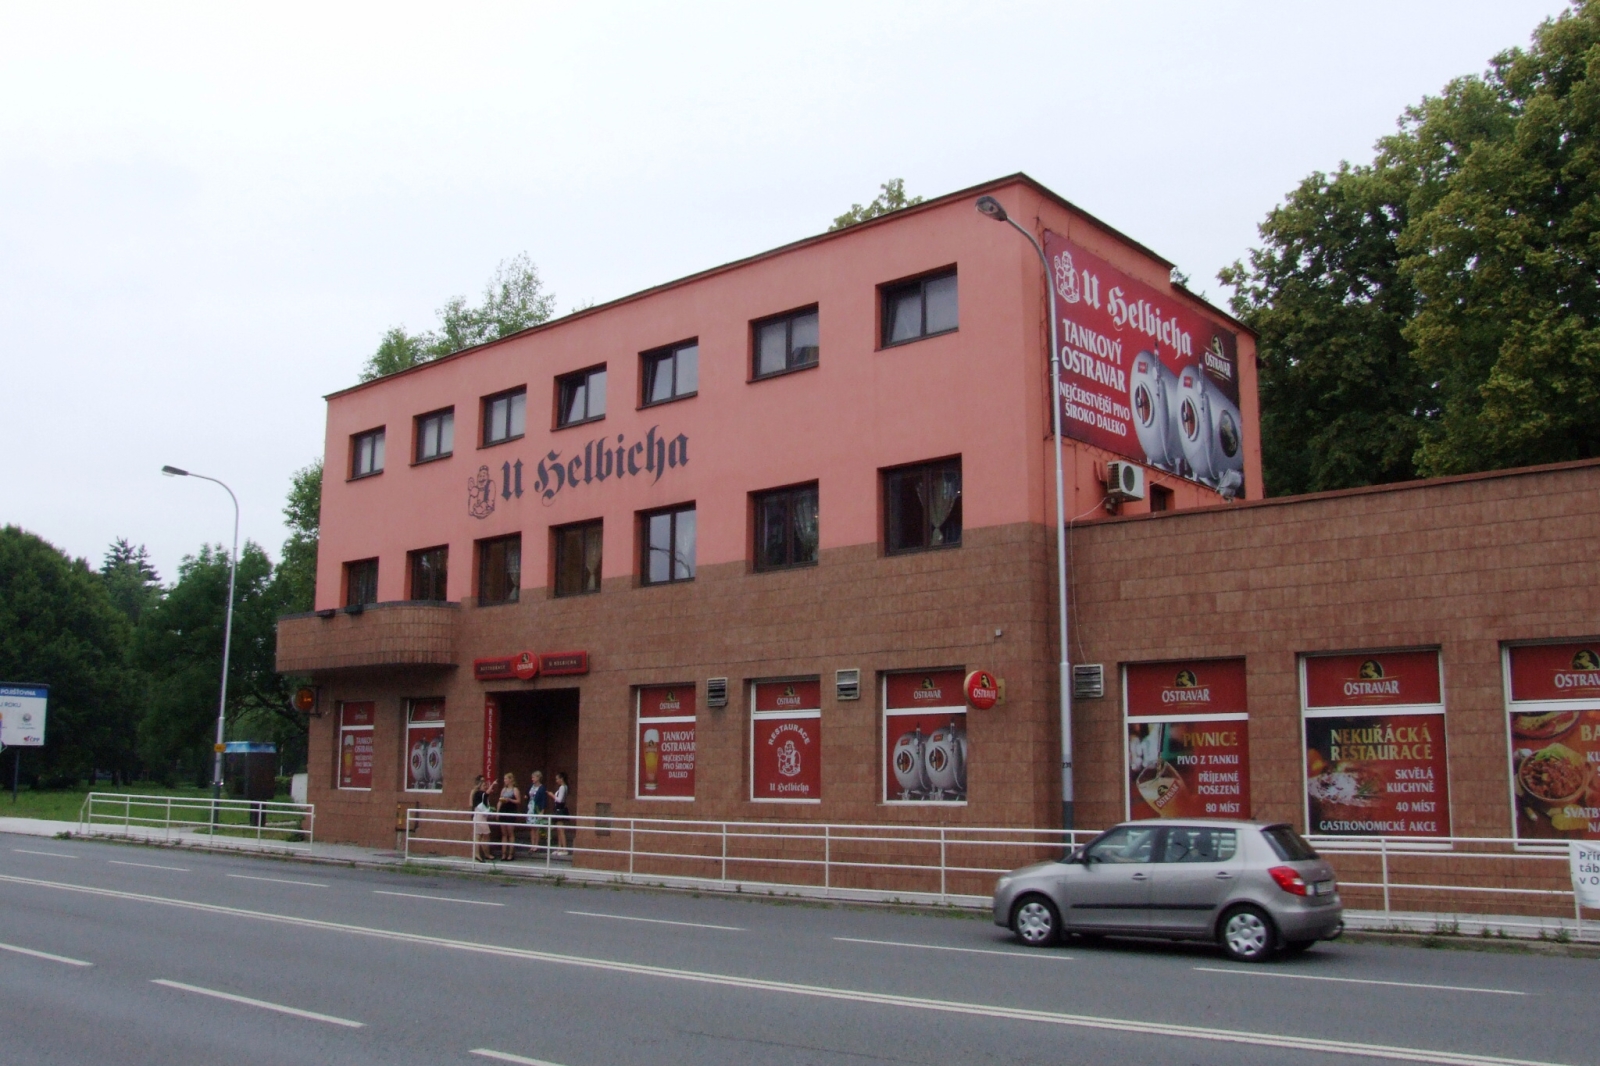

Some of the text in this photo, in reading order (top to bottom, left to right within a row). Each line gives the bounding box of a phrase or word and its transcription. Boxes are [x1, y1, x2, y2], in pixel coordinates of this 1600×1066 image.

[1082, 270, 1192, 360] U Helbicha
[1062, 319, 1122, 365] TANKOVÝ
[1061, 346, 1126, 393] OSTRAVAR
[1205, 352, 1232, 378] OSTRAVAR
[1059, 381, 1130, 420] NEJČERSTVĚJŠÍ PIVO
[1065, 398, 1127, 437] ŠIROKO DALEKO
[500, 424, 690, 507] U Helbicha
[913, 690, 942, 699] OSTRAVAR
[1343, 680, 1400, 695] OSTRAVAR
[1161, 688, 1211, 703] OSTRAVAR
[662, 729, 695, 741] TANKOVÝ
[768, 723, 811, 746] RESTAURACE
[1183, 731, 1238, 747] PIVNICE
[1331, 723, 1432, 744] NEKUŘÁCKÁ
[661, 742, 696, 752] OSTRAVAR
[1331, 744, 1433, 761] RESTAURACE
[1177, 754, 1239, 765] PIVO Z TANKU
[1198, 771, 1239, 784] PŘÍJEMNÉ
[1395, 766, 1434, 780] SKVĚLÁ
[769, 783, 809, 794] U Helbicha
[1197, 783, 1240, 795] POSEZENÍ
[1386, 782, 1435, 793] KUCHYNĚ
[1205, 802, 1240, 813] 80 MÍST
[1395, 800, 1436, 812] 40 MÍST
[1319, 819, 1437, 832] GASTRONOMICKÉ AKCE
[1579, 877, 1586, 885] v
